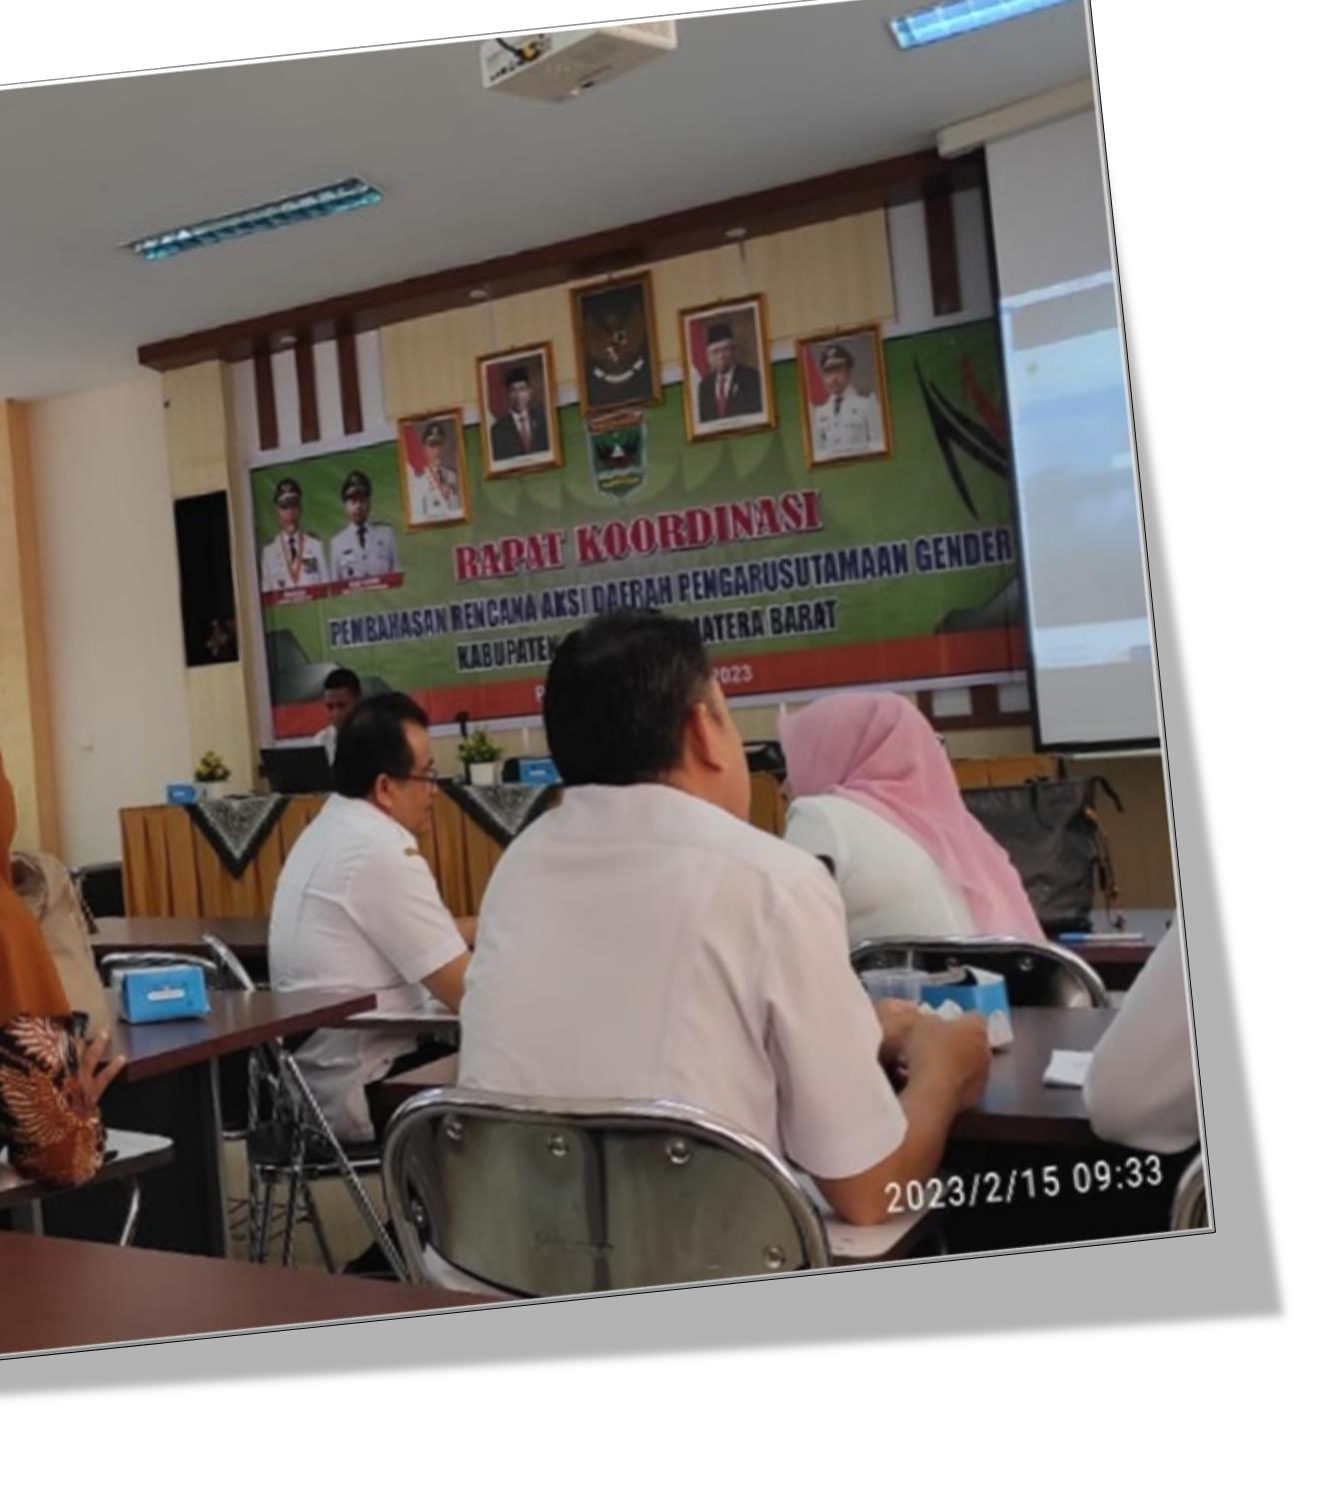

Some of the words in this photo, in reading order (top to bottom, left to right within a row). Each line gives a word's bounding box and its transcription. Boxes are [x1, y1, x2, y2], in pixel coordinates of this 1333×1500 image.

[455, 531, 564, 582] RAPAT
[575, 490, 823, 566] KOORDINASI
[329, 606, 448, 647] PEMBAHASAN
[451, 594, 537, 631] RENCANA
[541, 587, 588, 619] AKSI
[592, 575, 673, 614] DAERAH
[678, 543, 909, 602] PENGARUSUTAMAAN
[916, 529, 1013, 571] GENDER
[770, 601, 838, 635] BARAT
